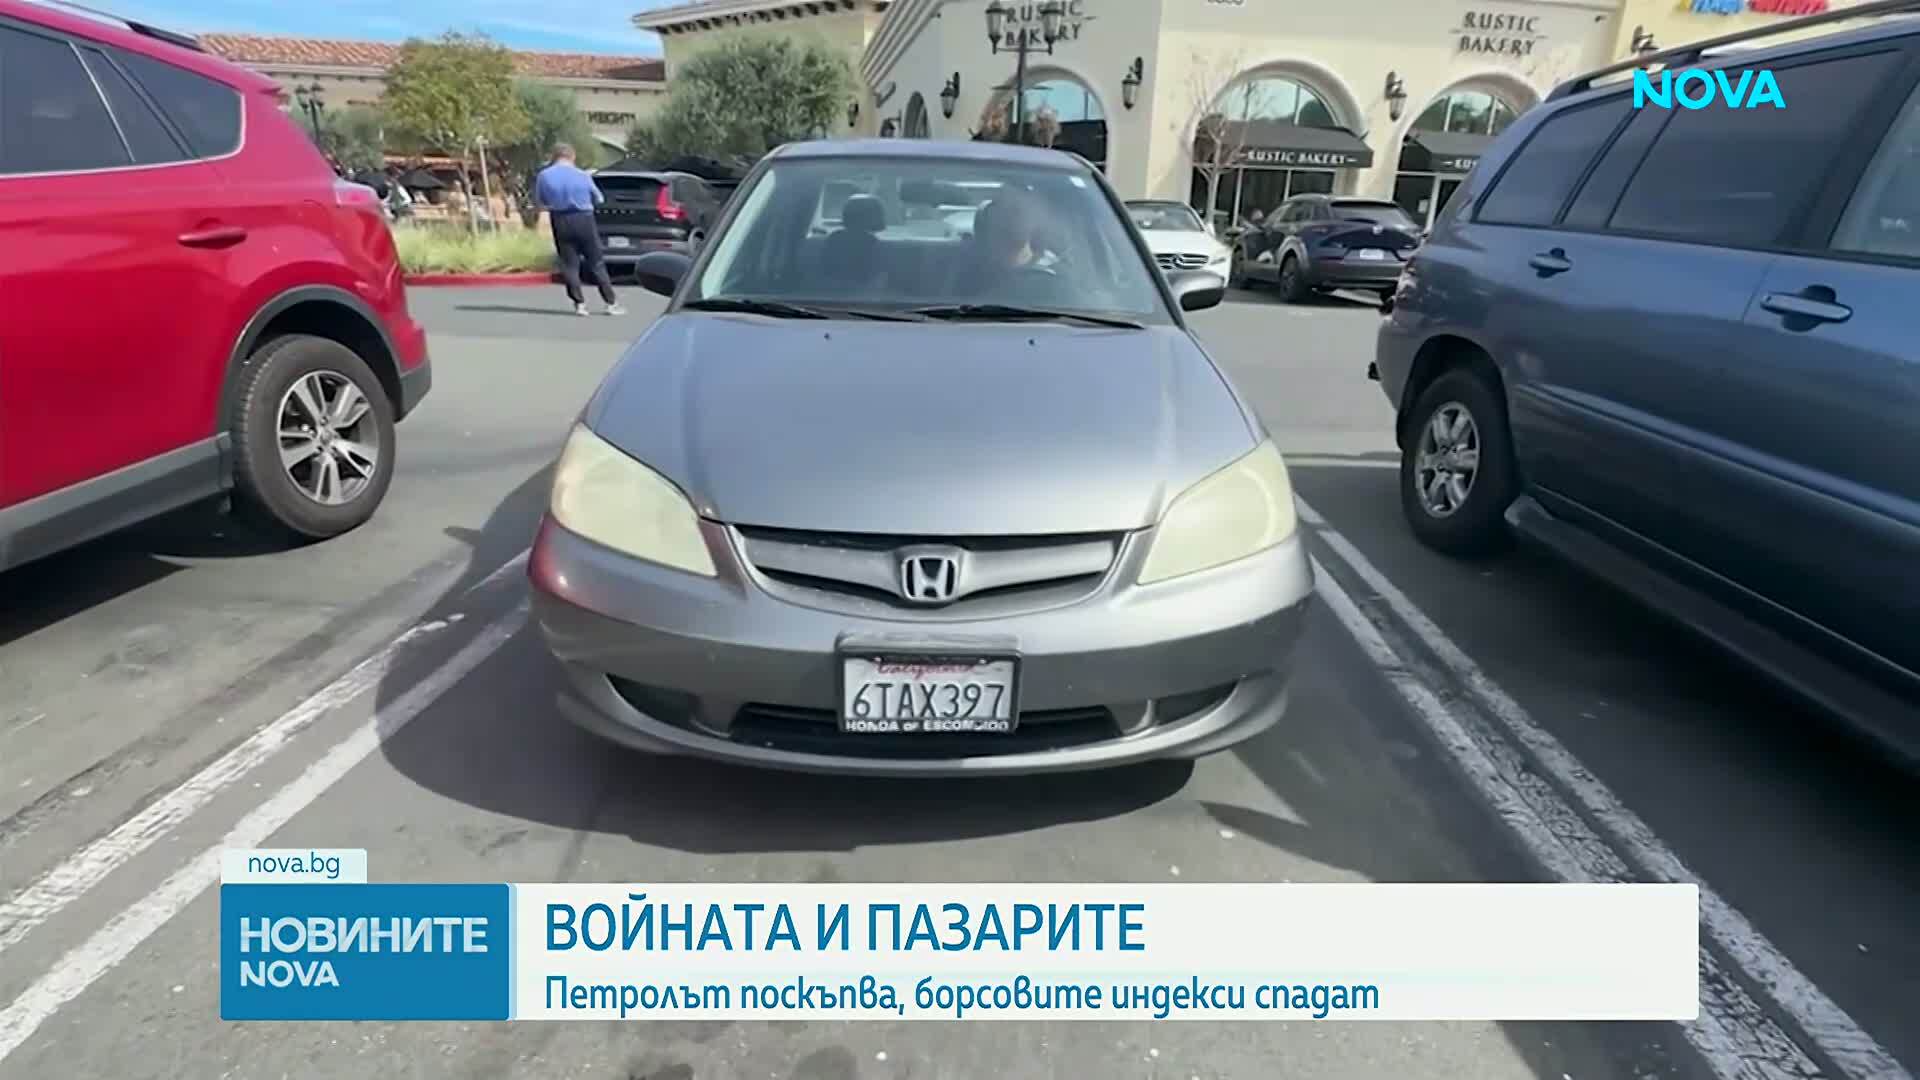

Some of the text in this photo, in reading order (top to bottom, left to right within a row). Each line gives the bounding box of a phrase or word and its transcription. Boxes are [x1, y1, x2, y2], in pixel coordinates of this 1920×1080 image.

[1463, 11, 1540, 32] RUSTIC
[1459, 35, 1536, 56] BAKERY
[1247, 151, 1295, 164] RUSTIC
[853, 683, 1005, 718] 6TAX397
[846, 720, 899, 731] HONDA
